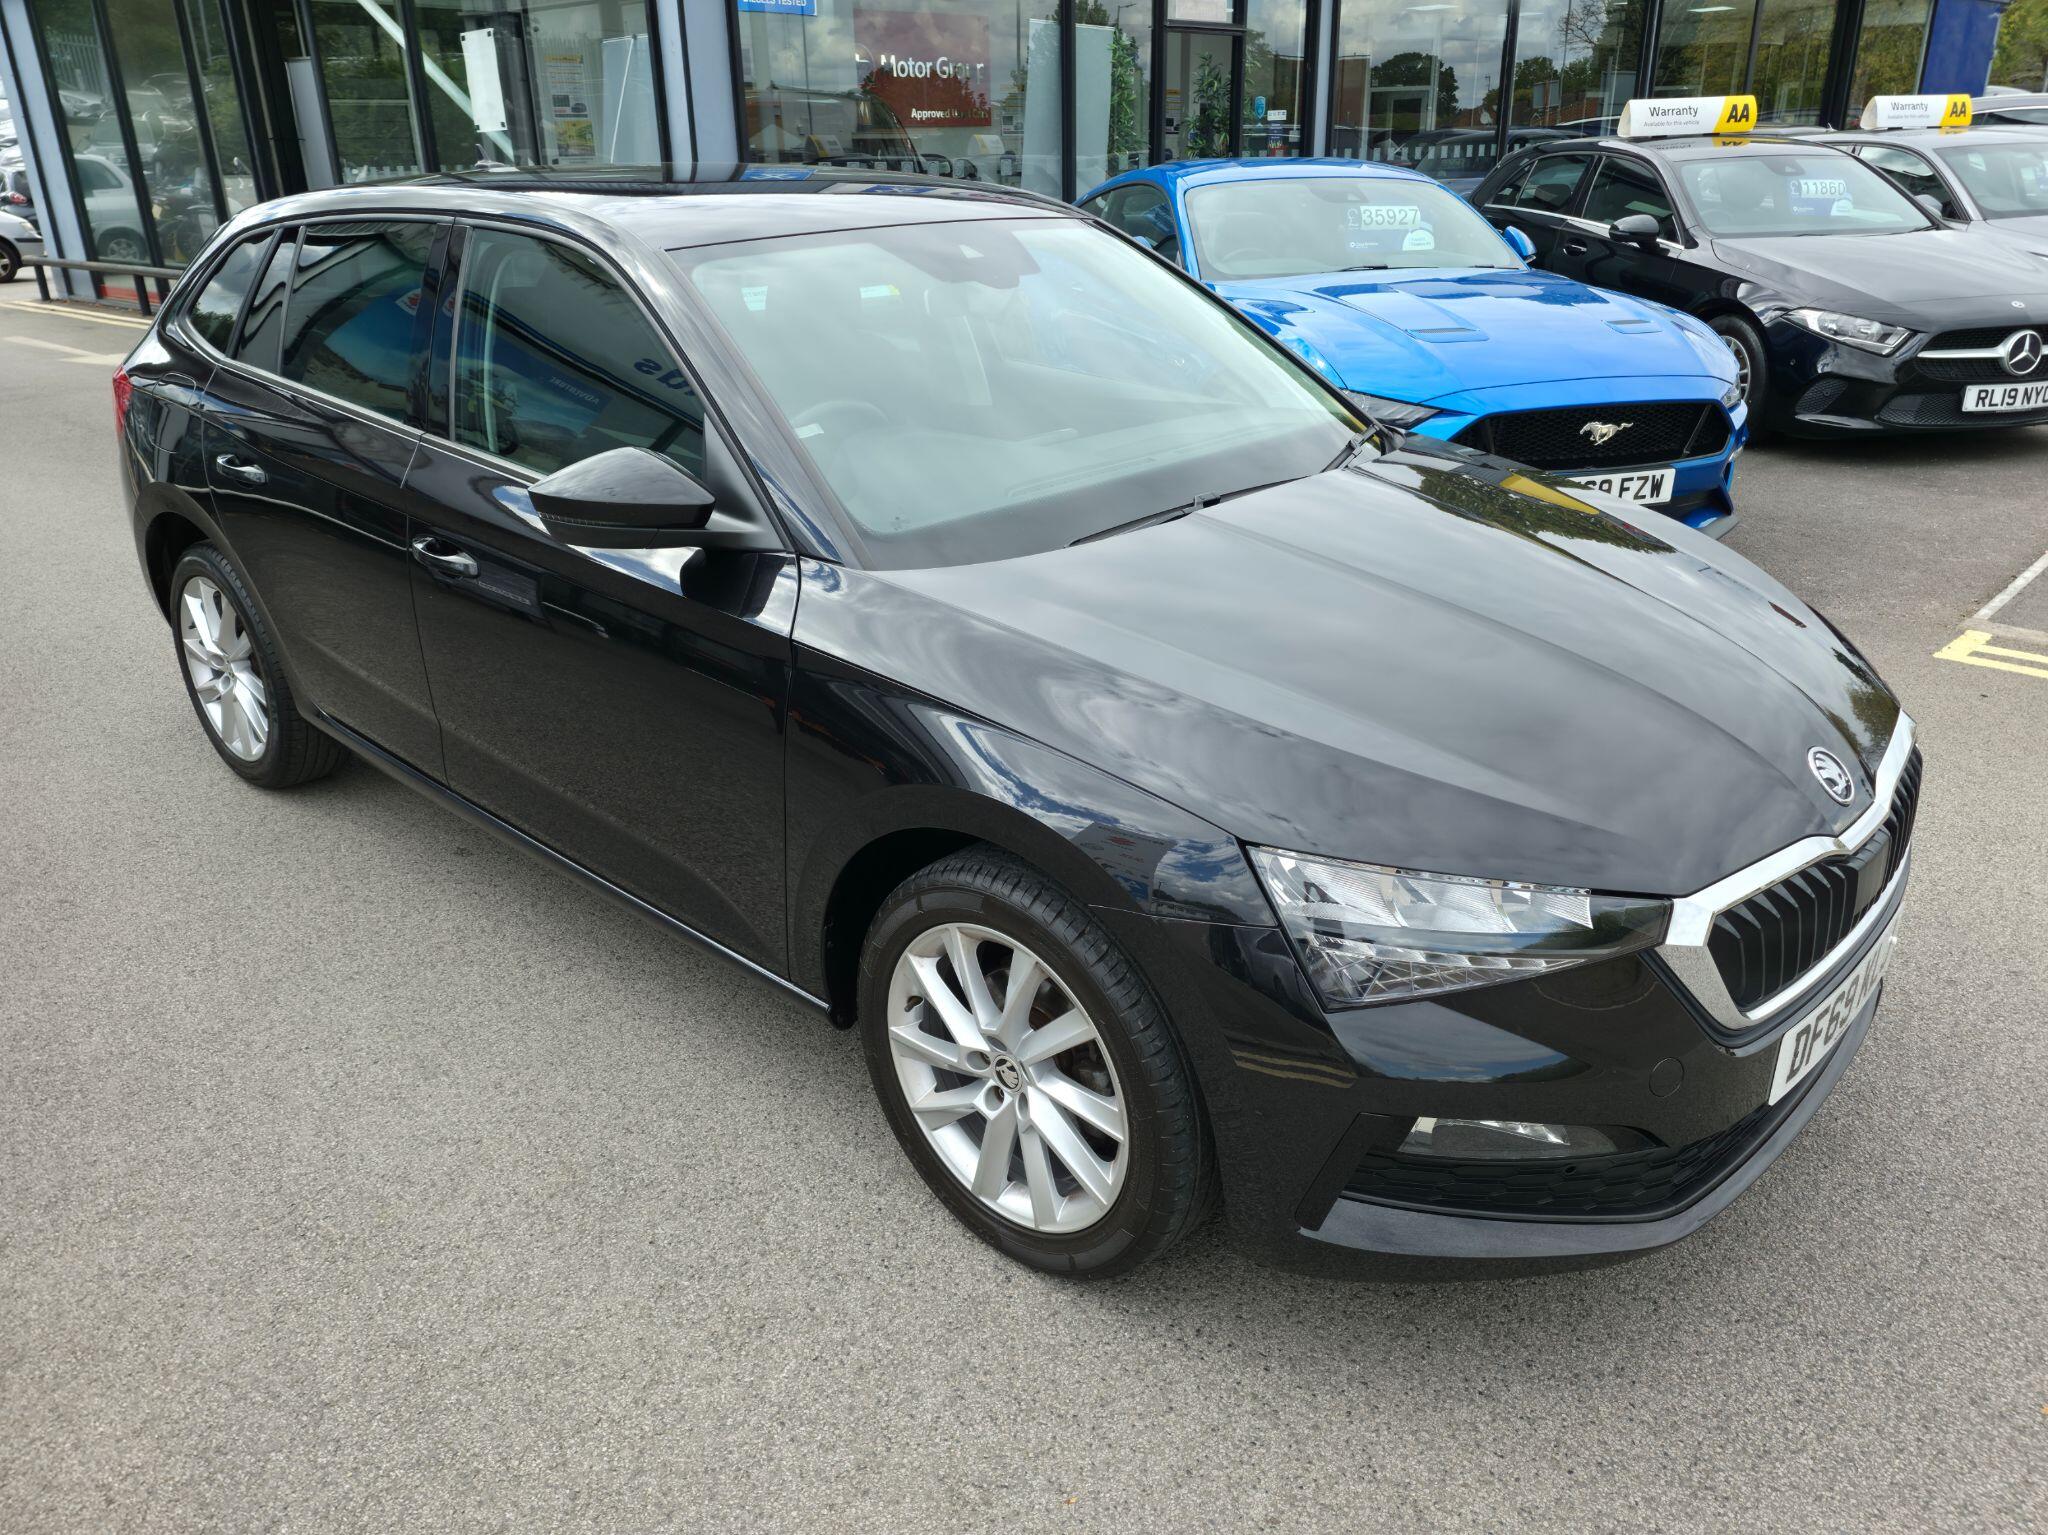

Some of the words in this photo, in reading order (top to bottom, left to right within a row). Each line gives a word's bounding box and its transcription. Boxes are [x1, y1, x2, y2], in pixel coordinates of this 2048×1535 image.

[880, 54, 933, 78] Motor
[911, 107, 951, 120] Approved
[1648, 105, 1699, 118] Warranty
[1726, 103, 1750, 123] AA
[1890, 101, 1929, 112] Warranty
[1949, 101, 1967, 118] AA
[1975, 388, 2019, 408] RL19
[1618, 474, 1665, 500] FZW
[1785, 974, 1860, 1084] DF69
